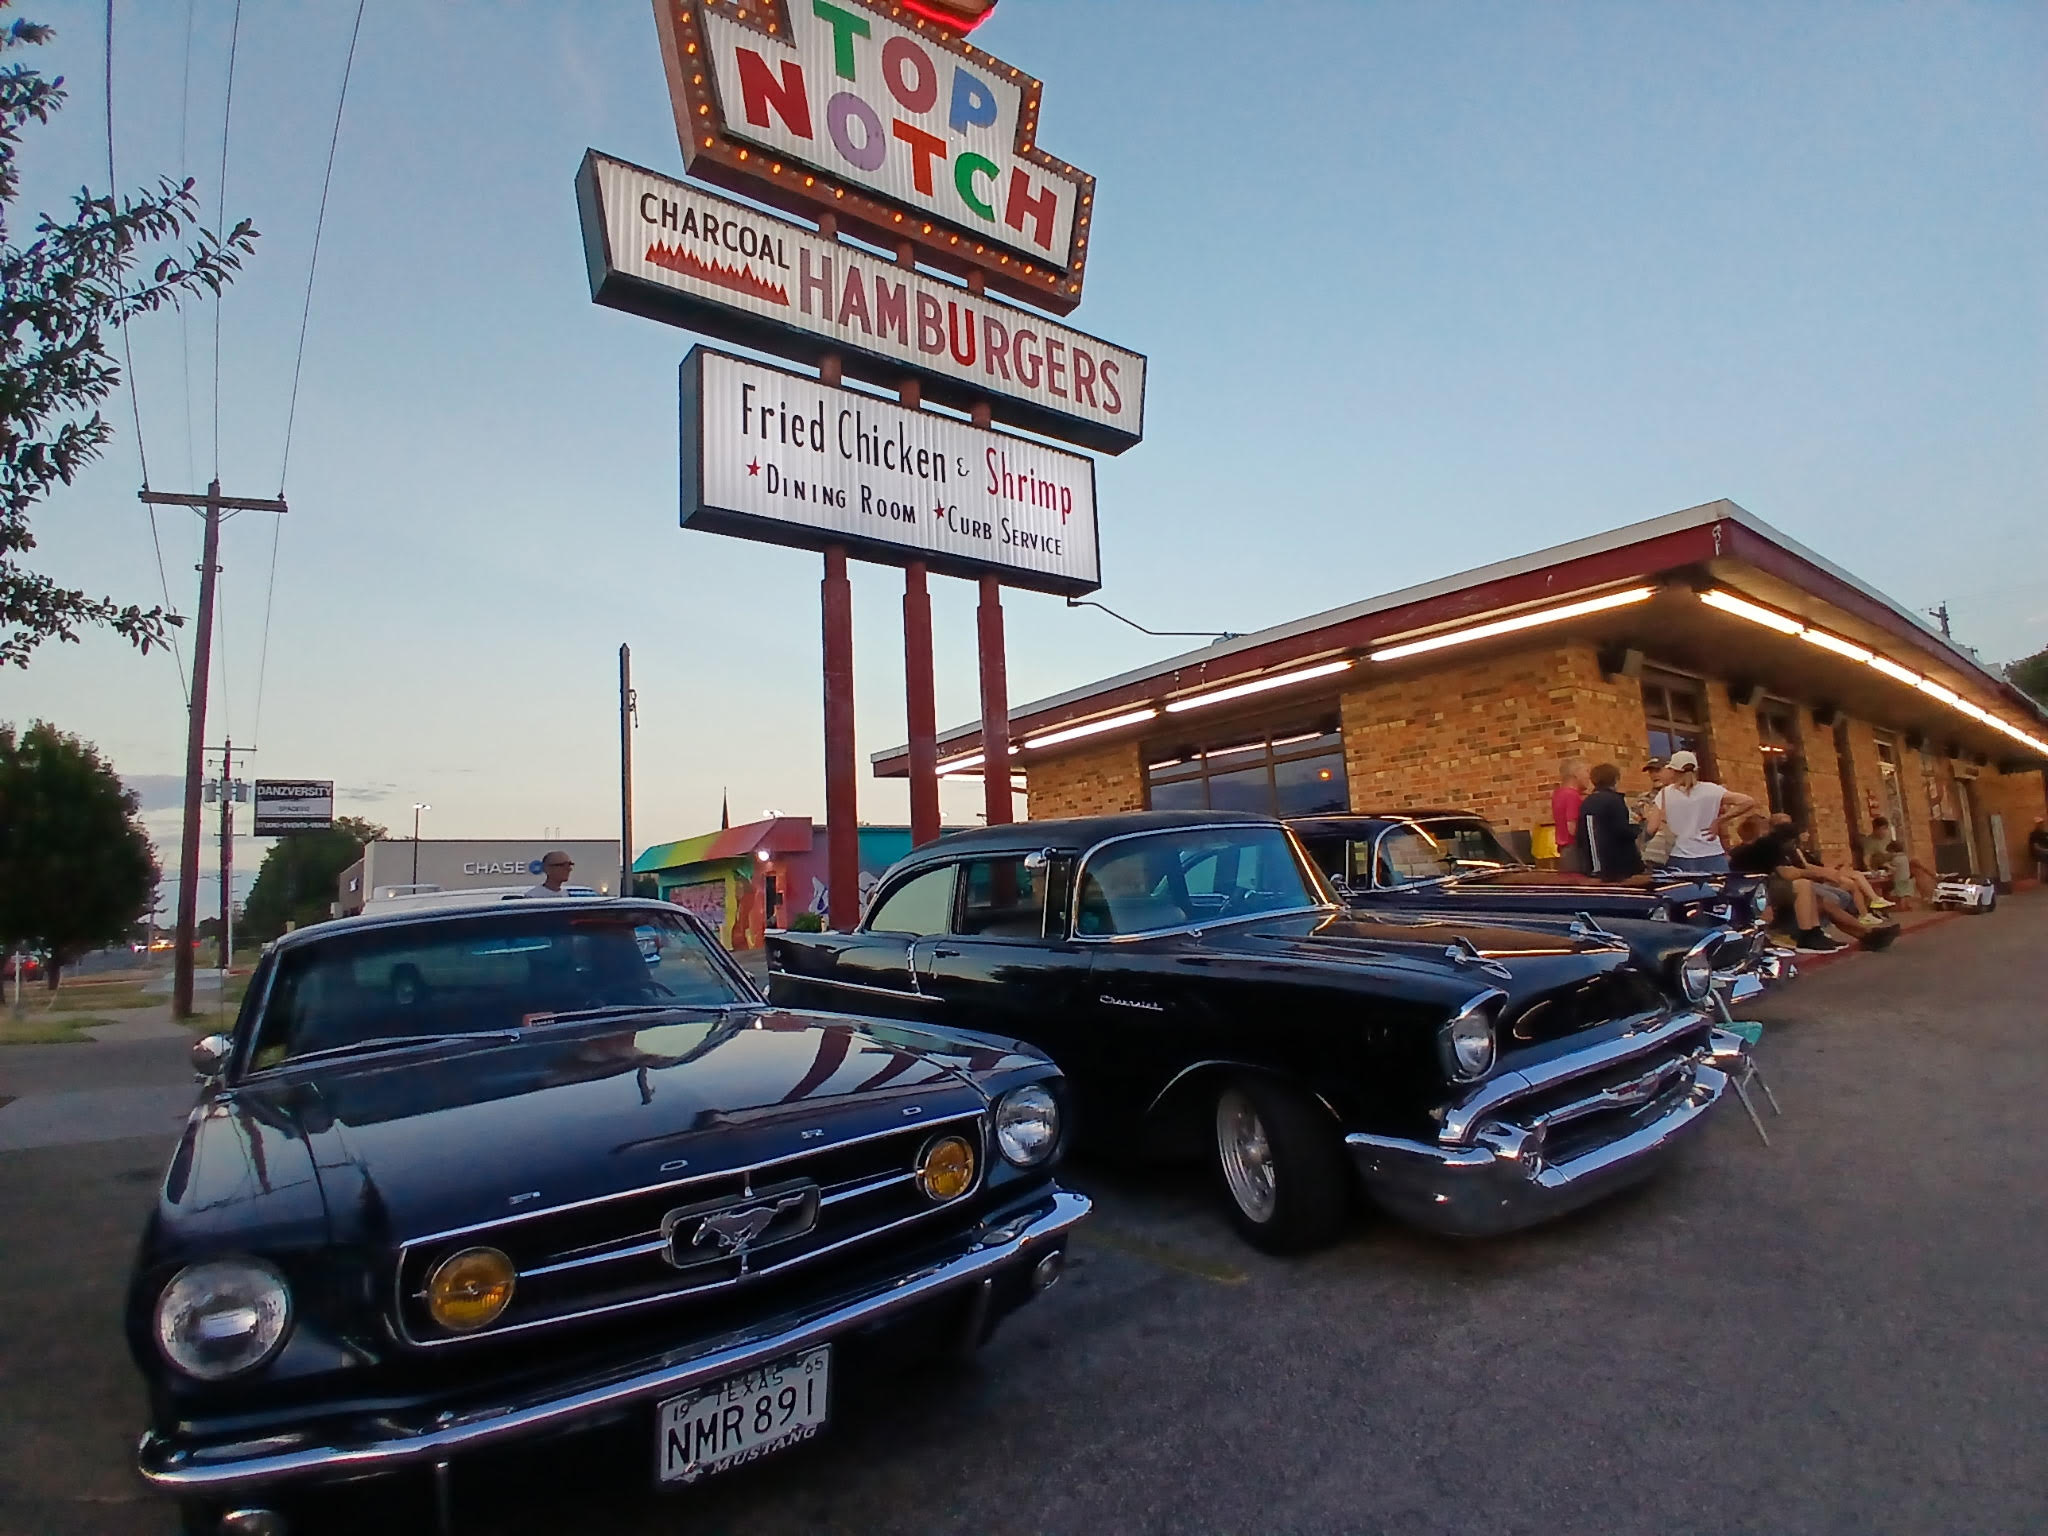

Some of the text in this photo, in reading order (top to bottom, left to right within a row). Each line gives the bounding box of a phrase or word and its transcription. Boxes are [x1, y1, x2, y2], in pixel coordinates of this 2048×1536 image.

[813, 0, 998, 137] TOP
[734, 46, 1058, 251] NOTCH
[639, 191, 791, 270] CHARCOAL
[799, 247, 1123, 415] HAMBURGERS
[741, 382, 826, 454] Fried
[838, 409, 947, 484] Chicken
[985, 447, 1073, 524] Shrimp
[766, 463, 1063, 556] DINING ROOM CURB SERVICE
[257, 785, 331, 797] DANZVERSITY
[463, 861, 526, 875] CHASE
[673, 1356, 824, 1422] 19 TEXAS 65
[710, 1425, 818, 1474] MUSTANG
